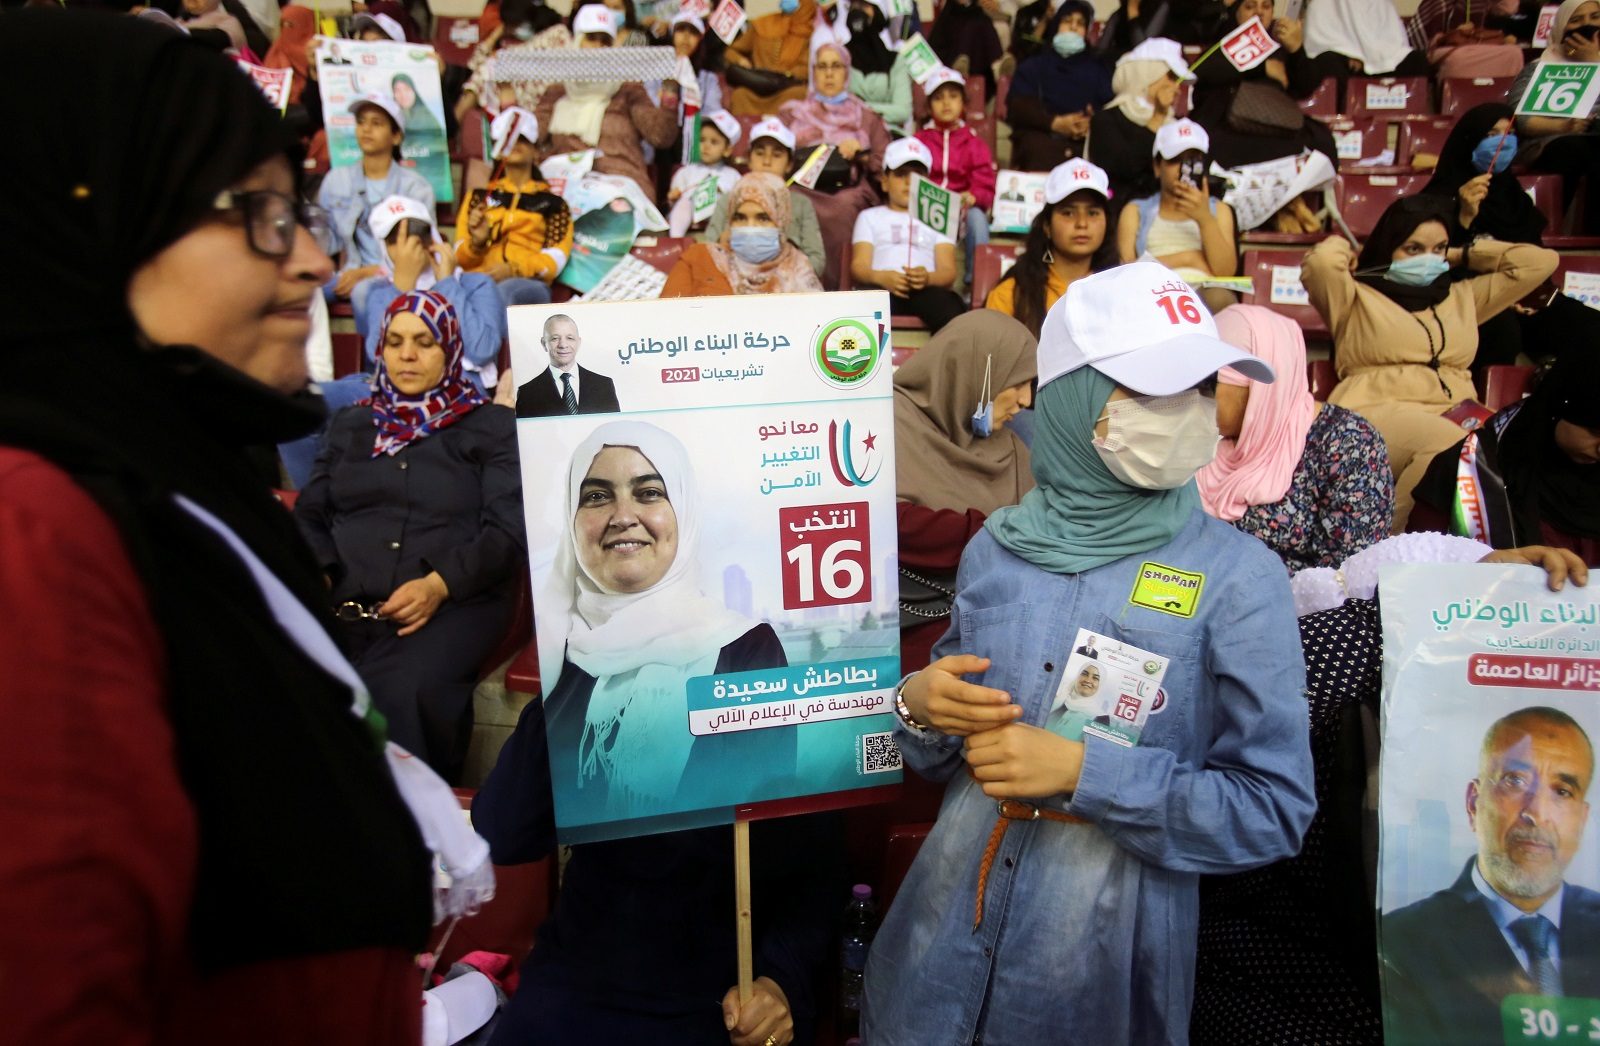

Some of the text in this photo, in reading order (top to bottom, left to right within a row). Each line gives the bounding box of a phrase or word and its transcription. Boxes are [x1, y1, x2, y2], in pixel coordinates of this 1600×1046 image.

[1227, 34, 1261, 64] 16
[1545, 66, 1591, 82] انتخب
[1532, 81, 1583, 112] 16
[1073, 169, 1090, 180] 16
[919, 195, 946, 231] 16
[1156, 295, 1201, 324] 16
[617, 332, 791, 366] حركة البناء الوطني
[665, 363, 764, 383] تشريعيات 2021
[758, 420, 819, 441] معا نحو
[760, 446, 820, 467] التغيير
[789, 509, 856, 540] انتخب
[786, 539, 865, 602] 16
[1144, 570, 1198, 588] SHONAN
[1432, 597, 1529, 632] الوطني
[713, 666, 878, 703] بطاطش سعيدة
[1474, 658, 1559, 682] العاصمة
[708, 694, 884, 732] مهندسة في الإعلام الآلي
[1117, 702, 1138, 720] 16
[1519, 1007, 1559, 1038] 30
